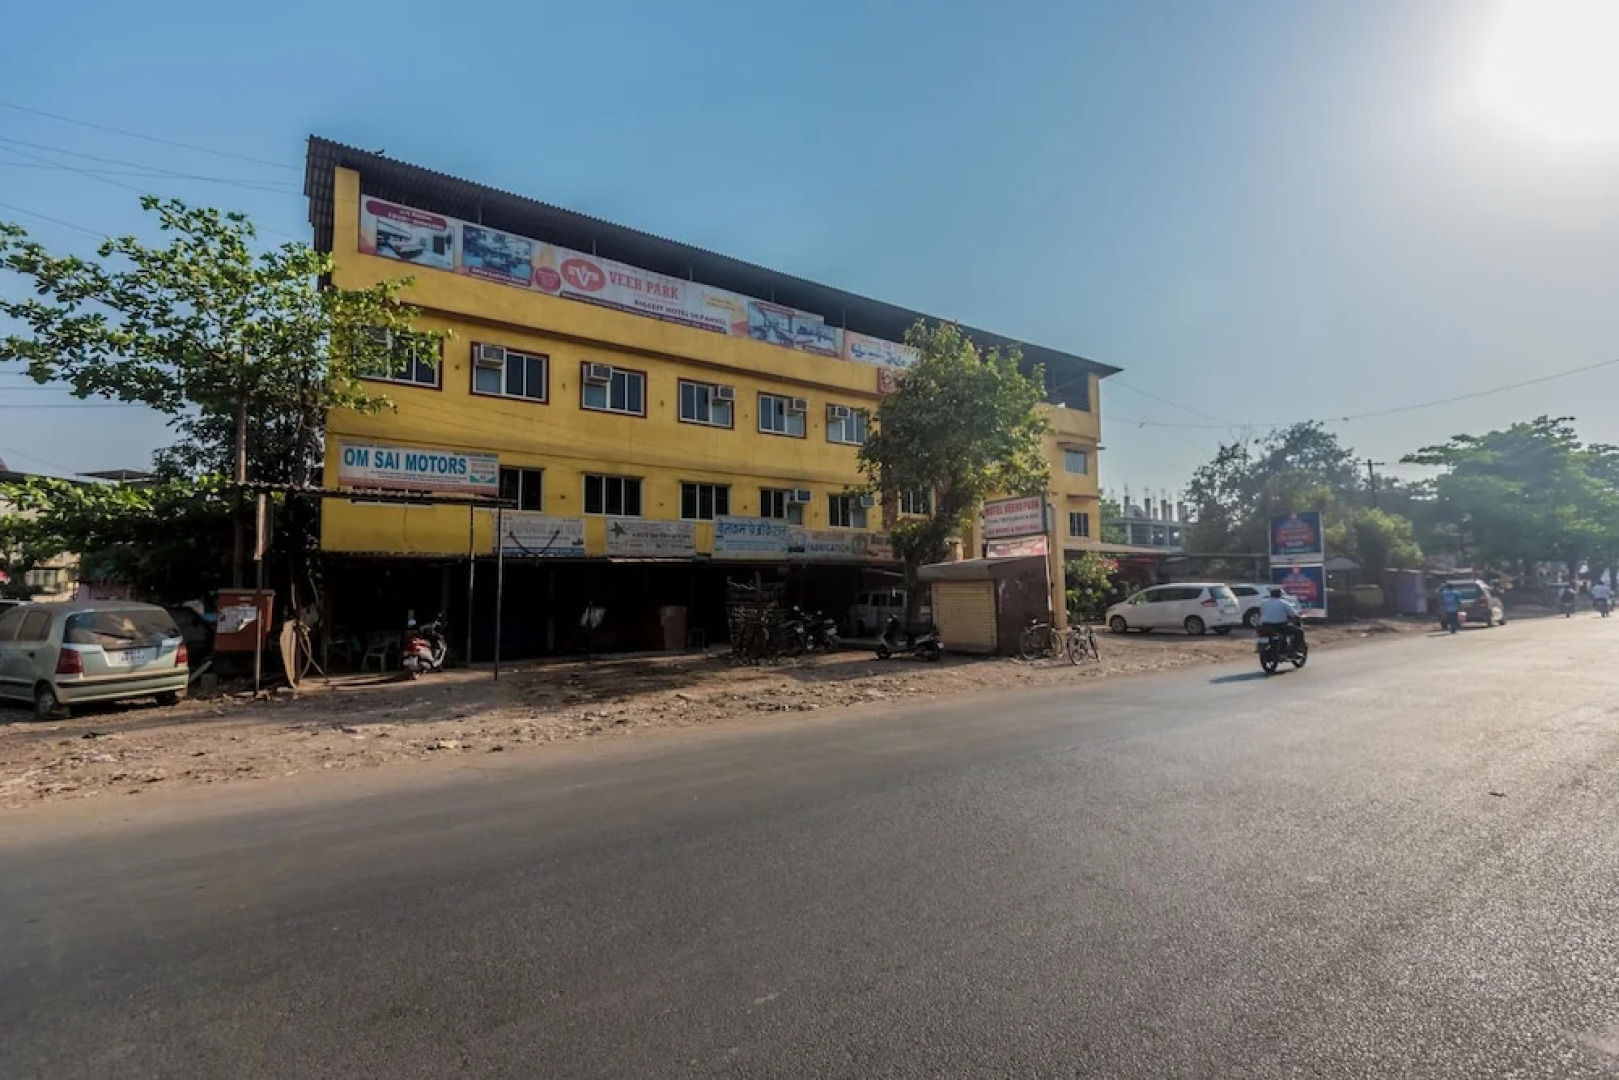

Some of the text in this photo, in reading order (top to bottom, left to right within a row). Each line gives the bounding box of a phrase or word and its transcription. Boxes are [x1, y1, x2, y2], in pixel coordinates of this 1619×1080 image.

[609, 271, 679, 299] VEER PARK
[634, 299, 664, 312] BIGGEST
[665, 306, 689, 317] HOTEL
[344, 448, 369, 467] OM
[375, 451, 399, 470] SAI
[405, 453, 467, 475] MOTORS
